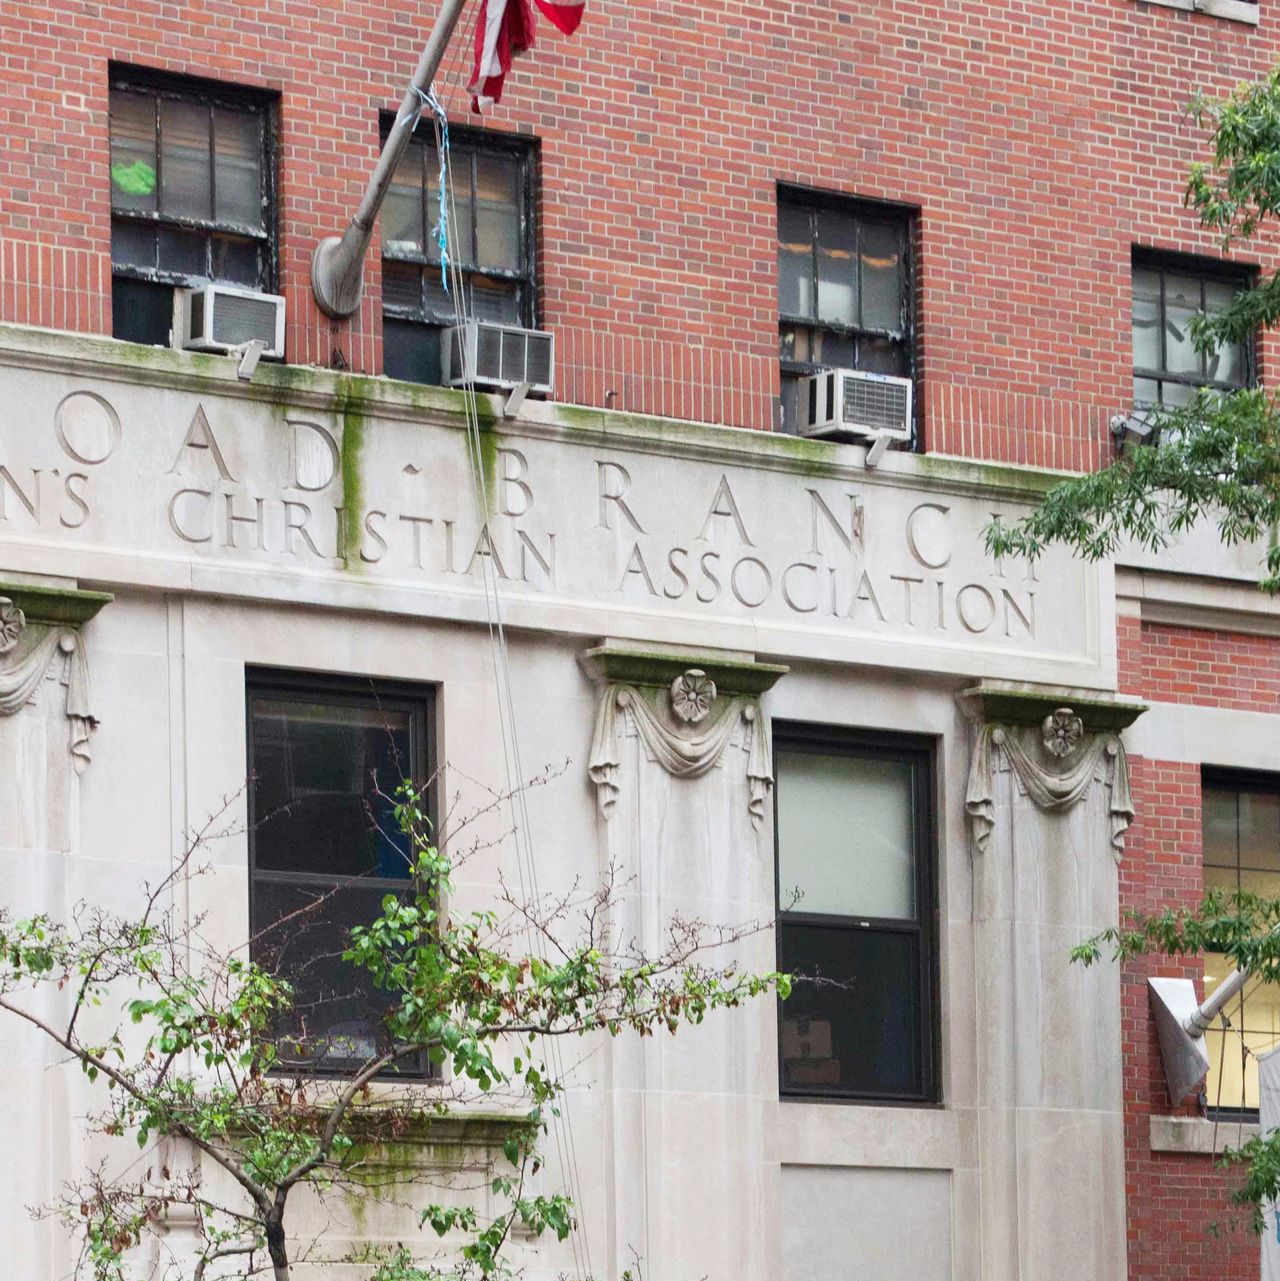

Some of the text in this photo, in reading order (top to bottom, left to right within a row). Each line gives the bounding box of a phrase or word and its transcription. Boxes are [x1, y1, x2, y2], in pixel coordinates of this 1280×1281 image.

[167, 487, 557, 589] CHRISTIAN
[617, 541, 1037, 640] ASSOCIATION
[495, 447, 1040, 582] BRANCH
